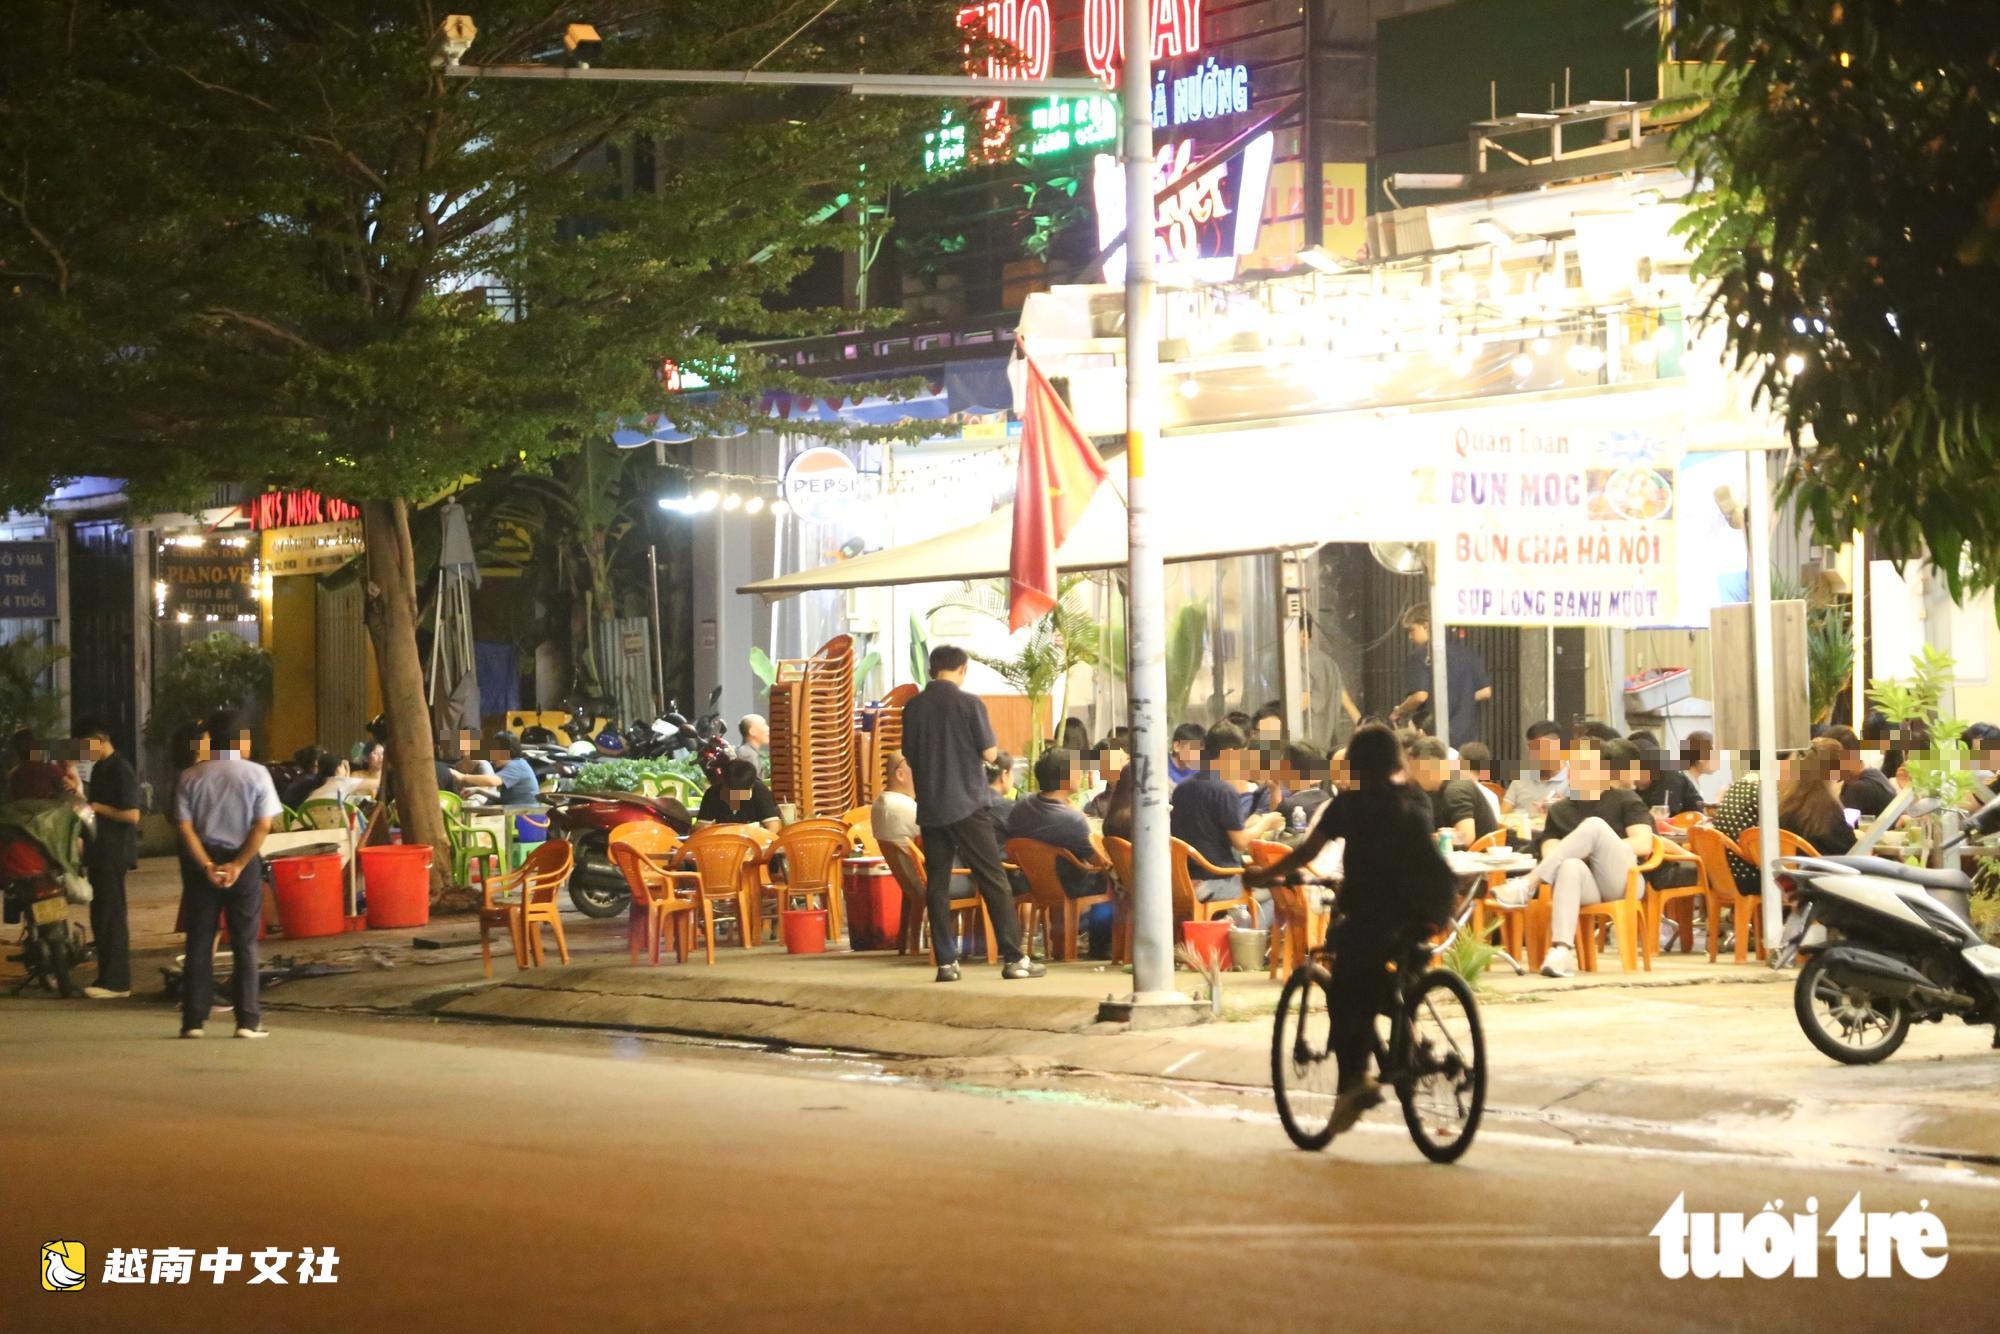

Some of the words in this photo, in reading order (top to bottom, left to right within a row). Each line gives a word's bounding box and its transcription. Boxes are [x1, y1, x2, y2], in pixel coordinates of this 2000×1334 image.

[1083, 0, 1200, 90] QAY
[1173, 57, 1248, 124] NƯỚNG
[793, 478, 856, 493] PEPSI
[1577, 525, 1610, 564] HÀ
[1619, 525, 1660, 575] NỘI
